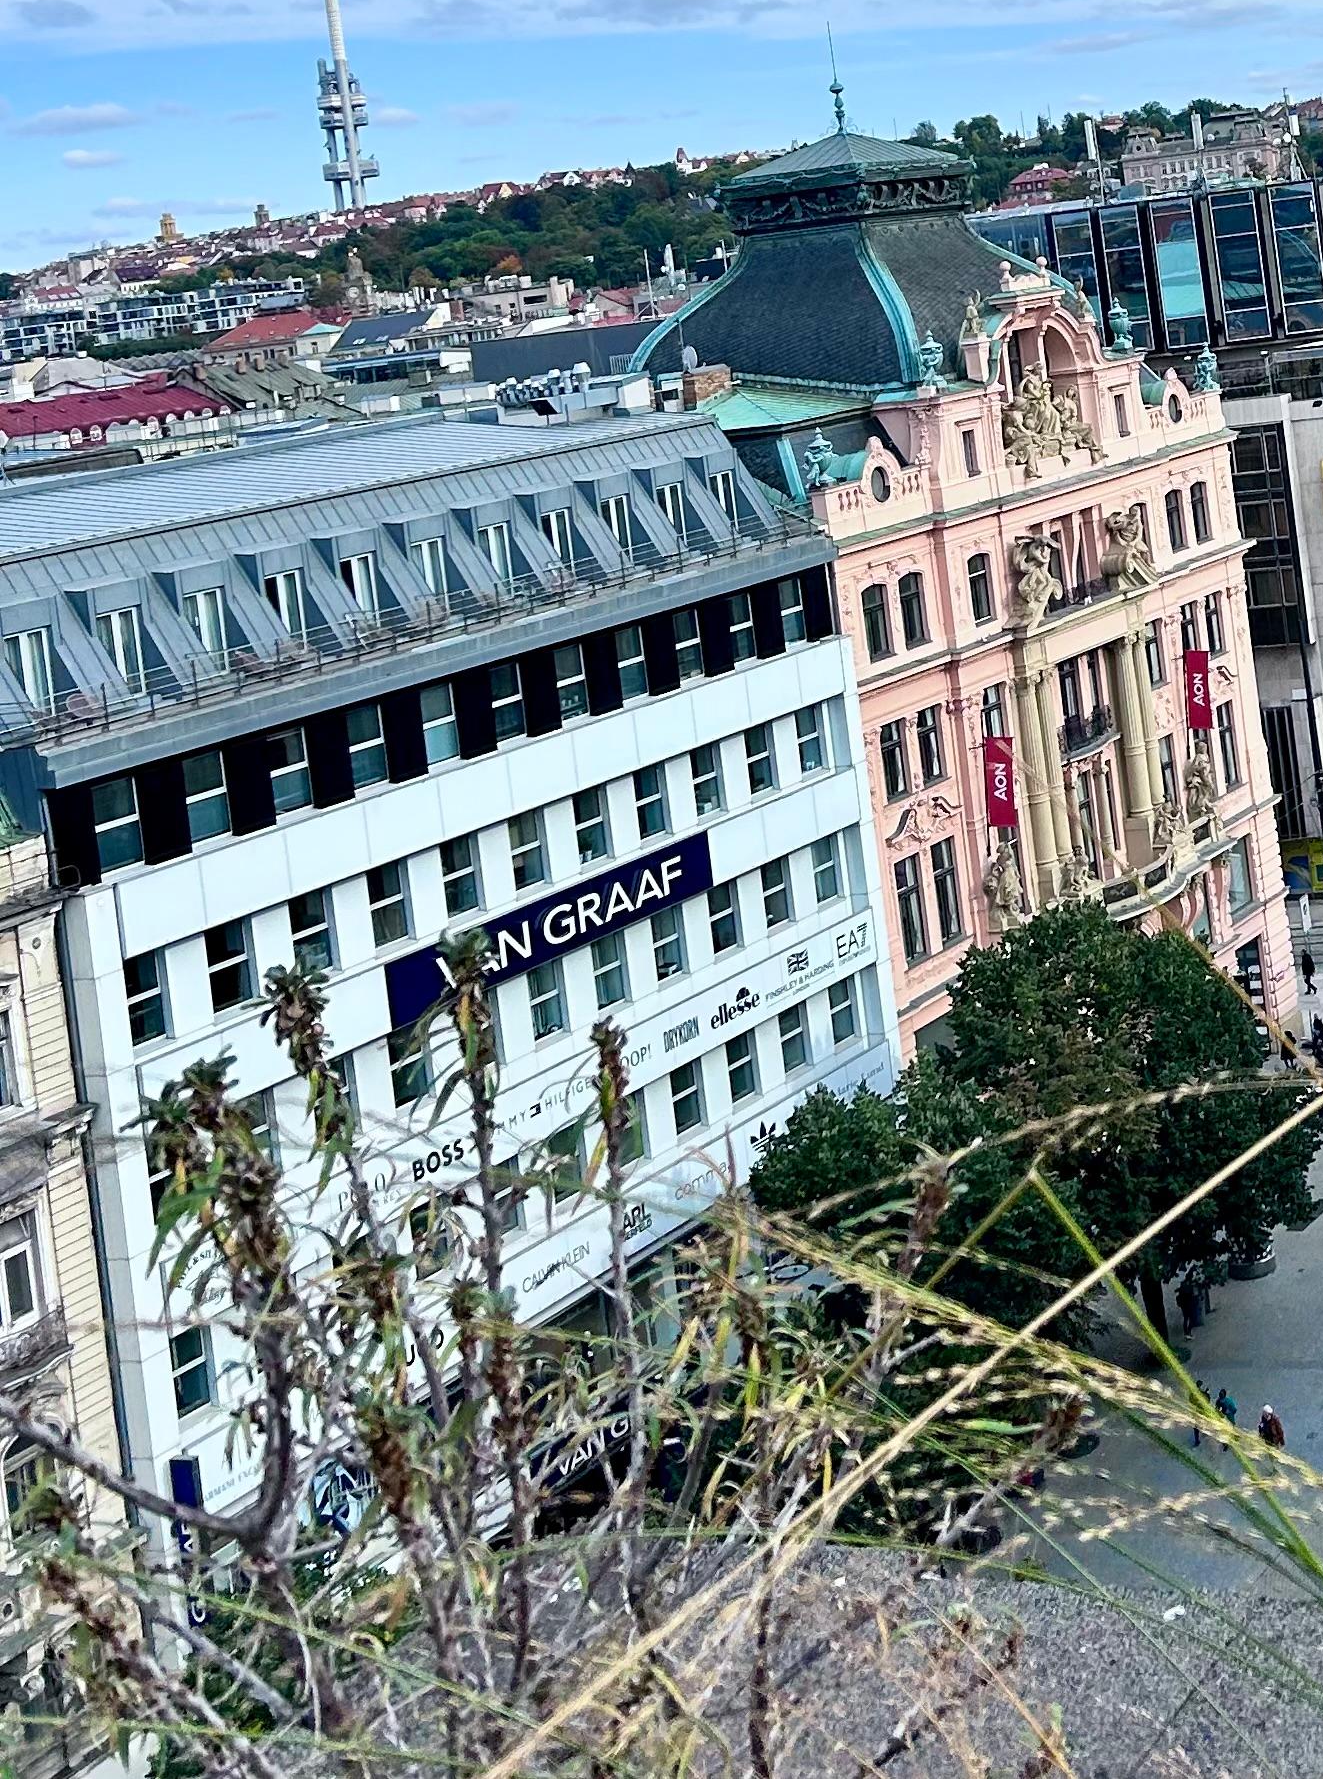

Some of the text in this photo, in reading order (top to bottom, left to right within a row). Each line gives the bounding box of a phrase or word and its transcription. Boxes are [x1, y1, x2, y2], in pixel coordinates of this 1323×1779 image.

[1192, 673, 1205, 707] AON
[994, 763, 1008, 801] AON
[543, 855, 683, 945] GRAAF
[836, 922, 868, 959] EA7
[710, 991, 760, 1030] ellesse
[663, 1015, 701, 1054] DRYKORN
[620, 1043, 652, 1070] OOP!
[412, 1138, 465, 1183] BOSS
[561, 1241, 591, 1268] KLEIN
